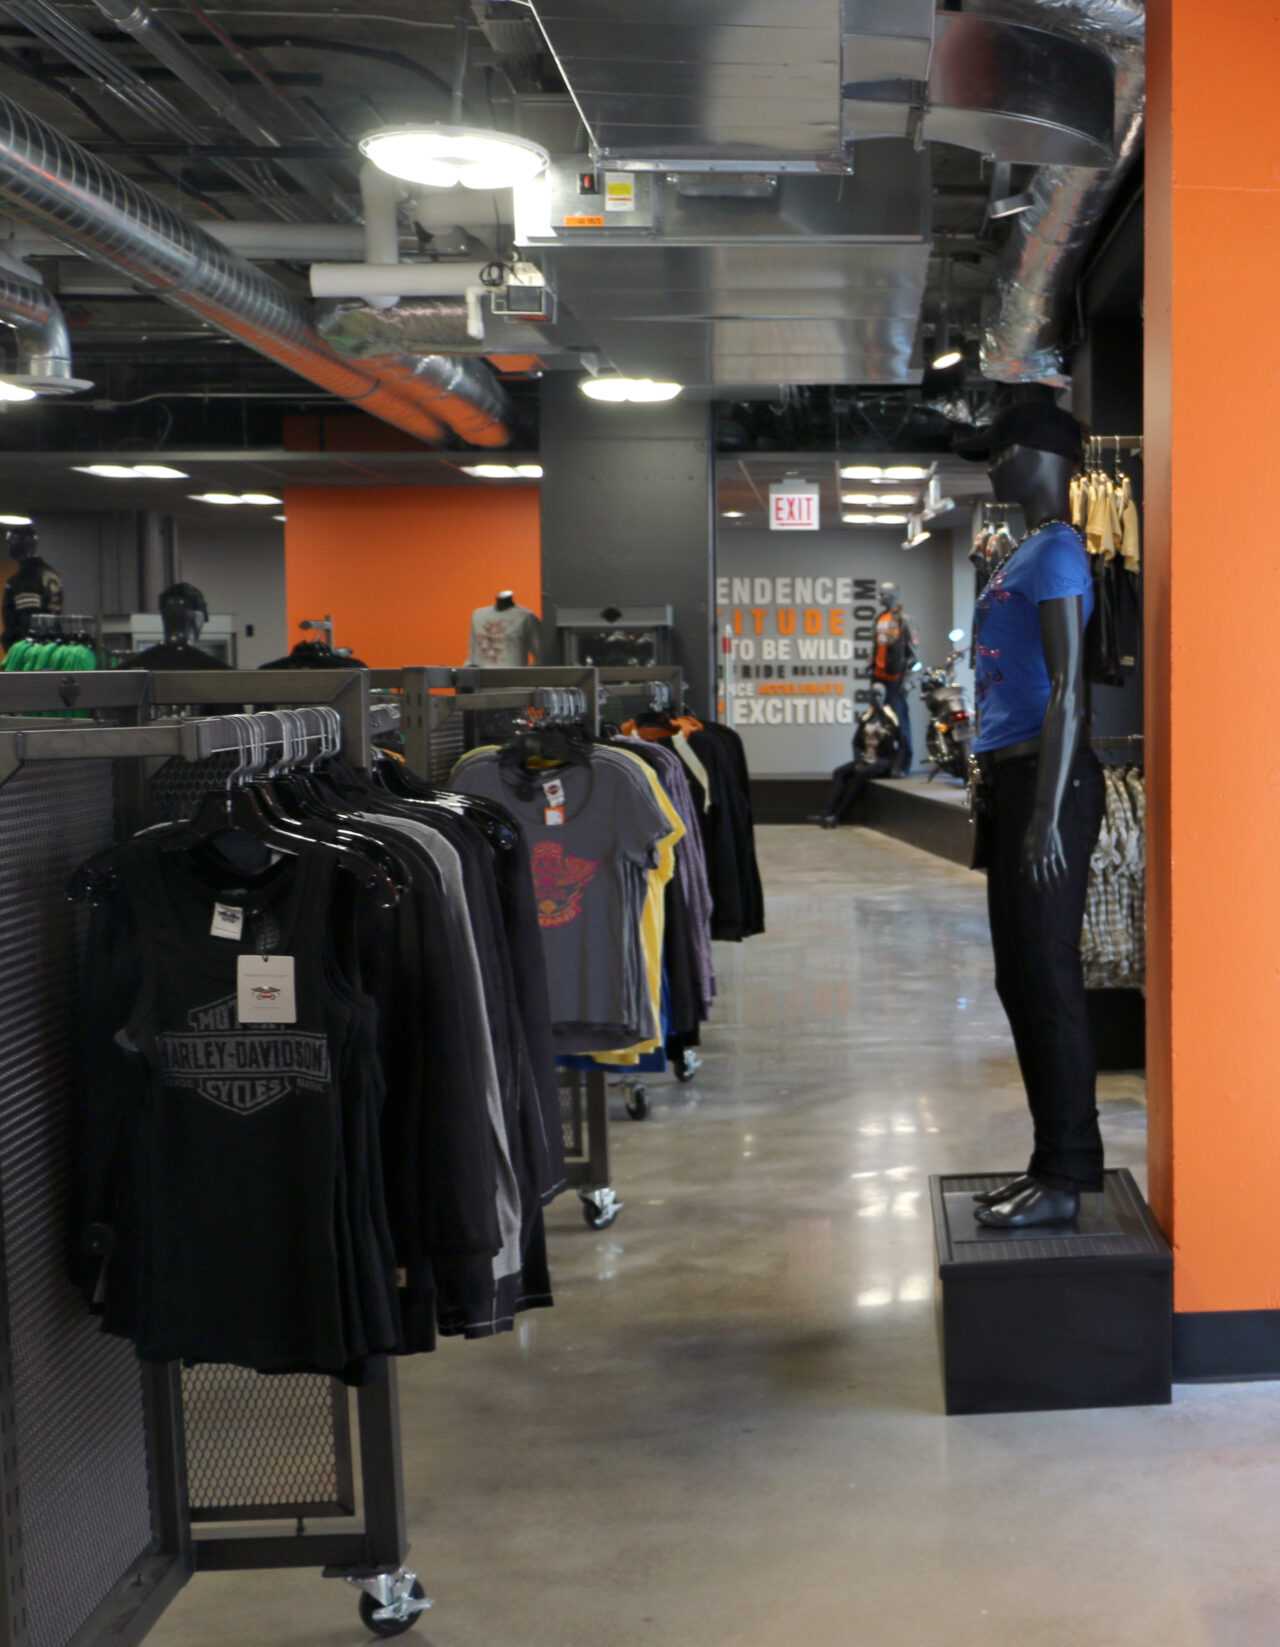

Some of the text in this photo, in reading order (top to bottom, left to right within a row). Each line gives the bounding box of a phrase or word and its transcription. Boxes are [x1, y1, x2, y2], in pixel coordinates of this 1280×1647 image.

[775, 497, 813, 521] EXIT
[717, 609, 846, 636] ITUDE
[762, 638, 791, 661] BE
[797, 638, 852, 661] WILD
[741, 664, 786, 679] RIDE
[791, 665, 849, 677] RELEASE
[758, 682, 844, 696] ACCELERATE
[733, 698, 853, 725] EXCITING
